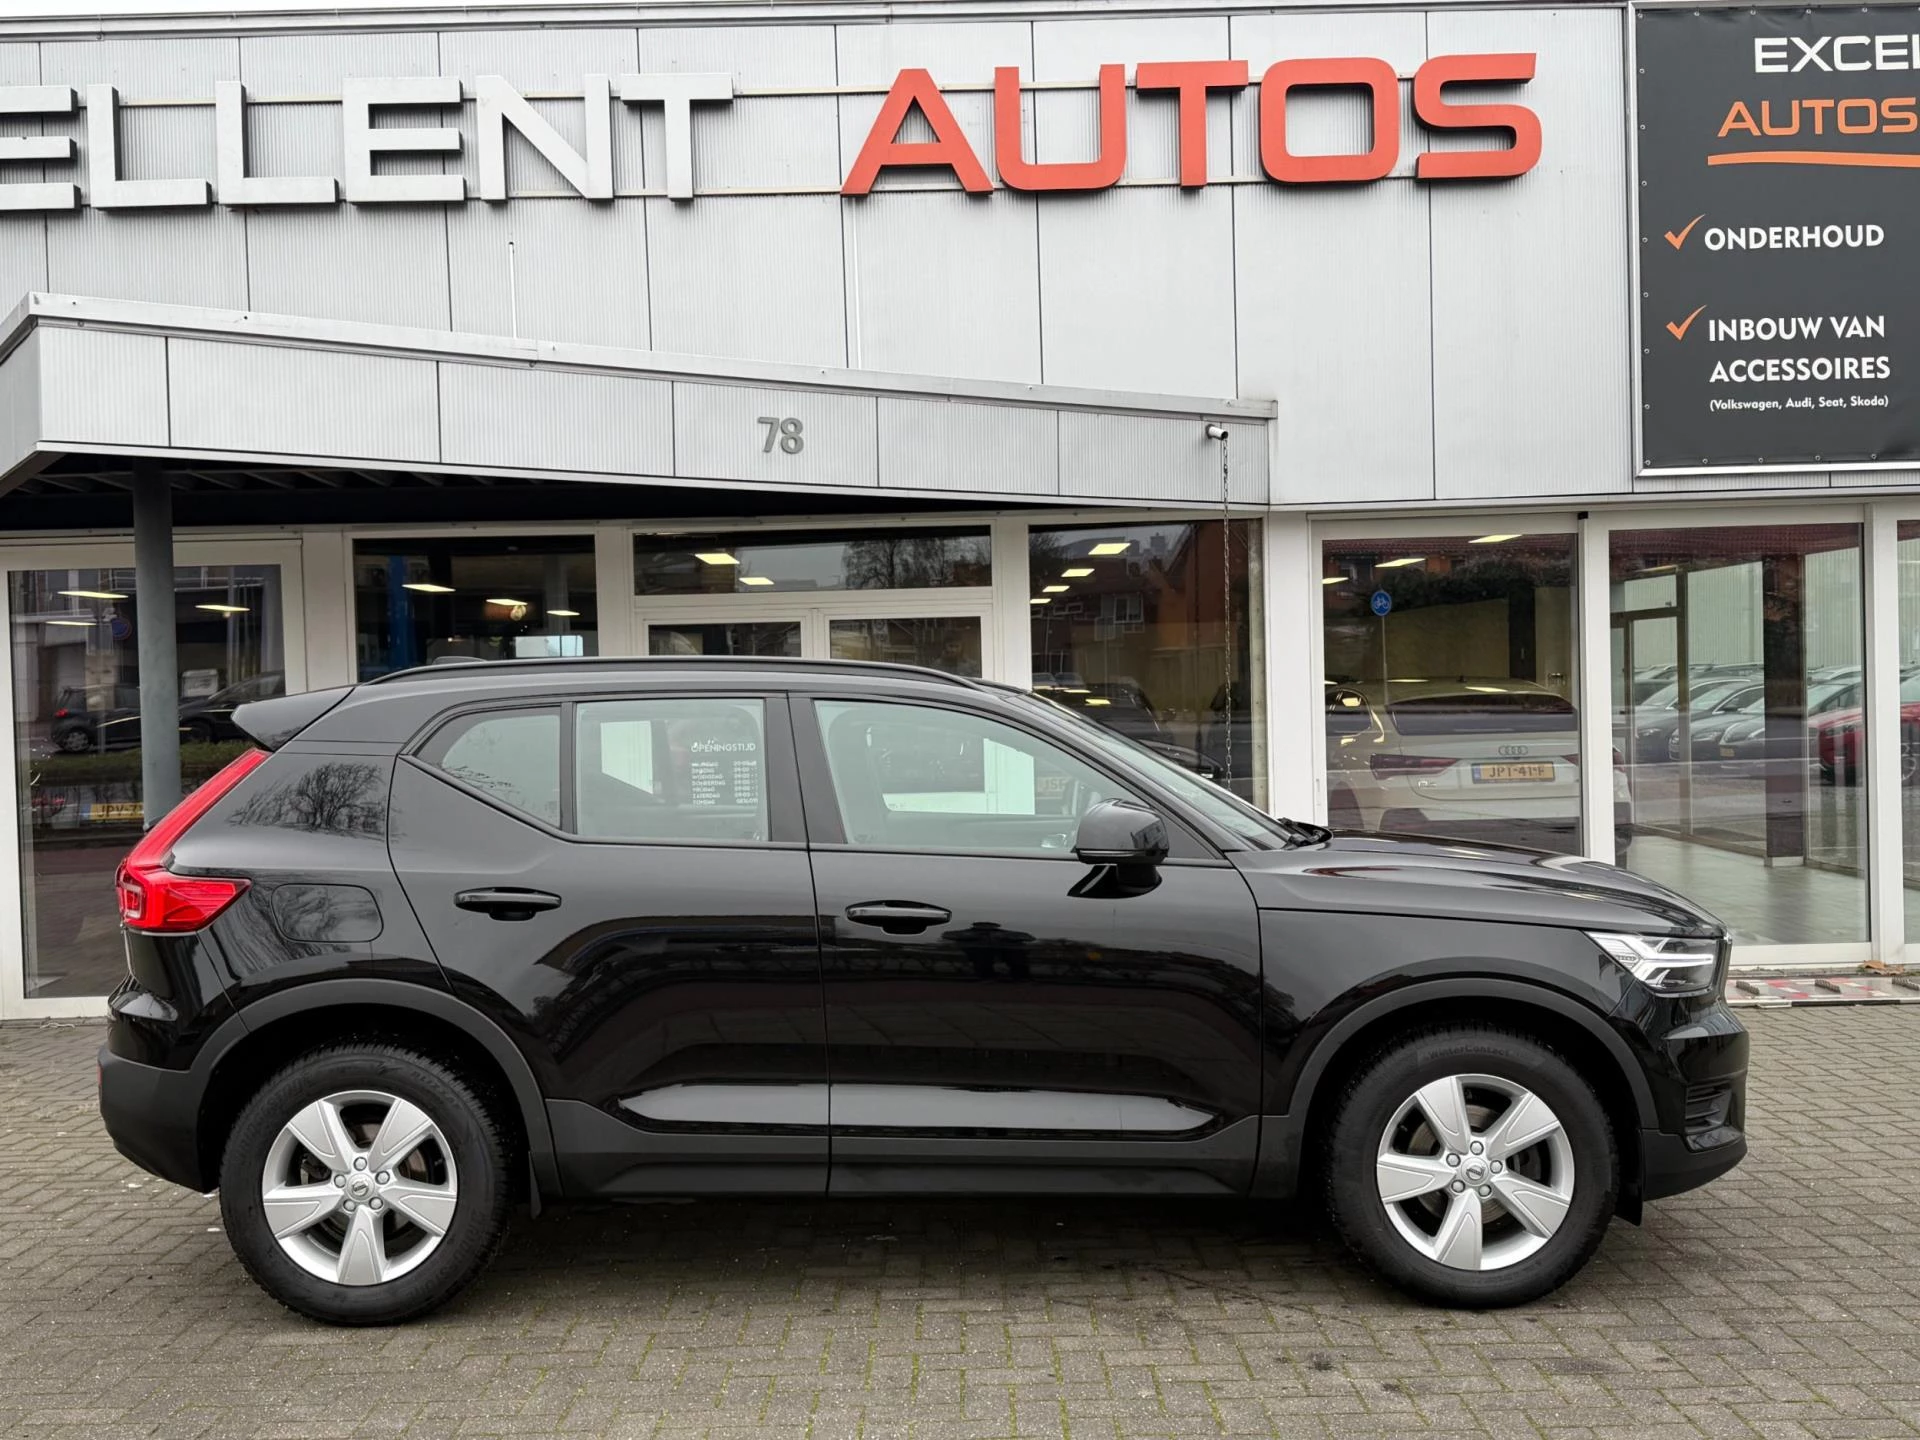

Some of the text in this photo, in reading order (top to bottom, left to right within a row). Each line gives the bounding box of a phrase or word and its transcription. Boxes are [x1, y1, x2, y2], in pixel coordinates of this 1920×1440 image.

[1754, 34, 1920, 73] EXCE
[840, 52, 1543, 197] AUTOS
[1717, 97, 1918, 137] AUTOS
[1704, 224, 1885, 251] ONDERHOUD
[1708, 315, 1885, 342] INBOUW VAN
[1709, 356, 1891, 383] ACCESSOIRES
[1709, 395, 1889, 412] (Volkswagen, Audi, Seat, Skoda)
[757, 416, 804, 454] 78
